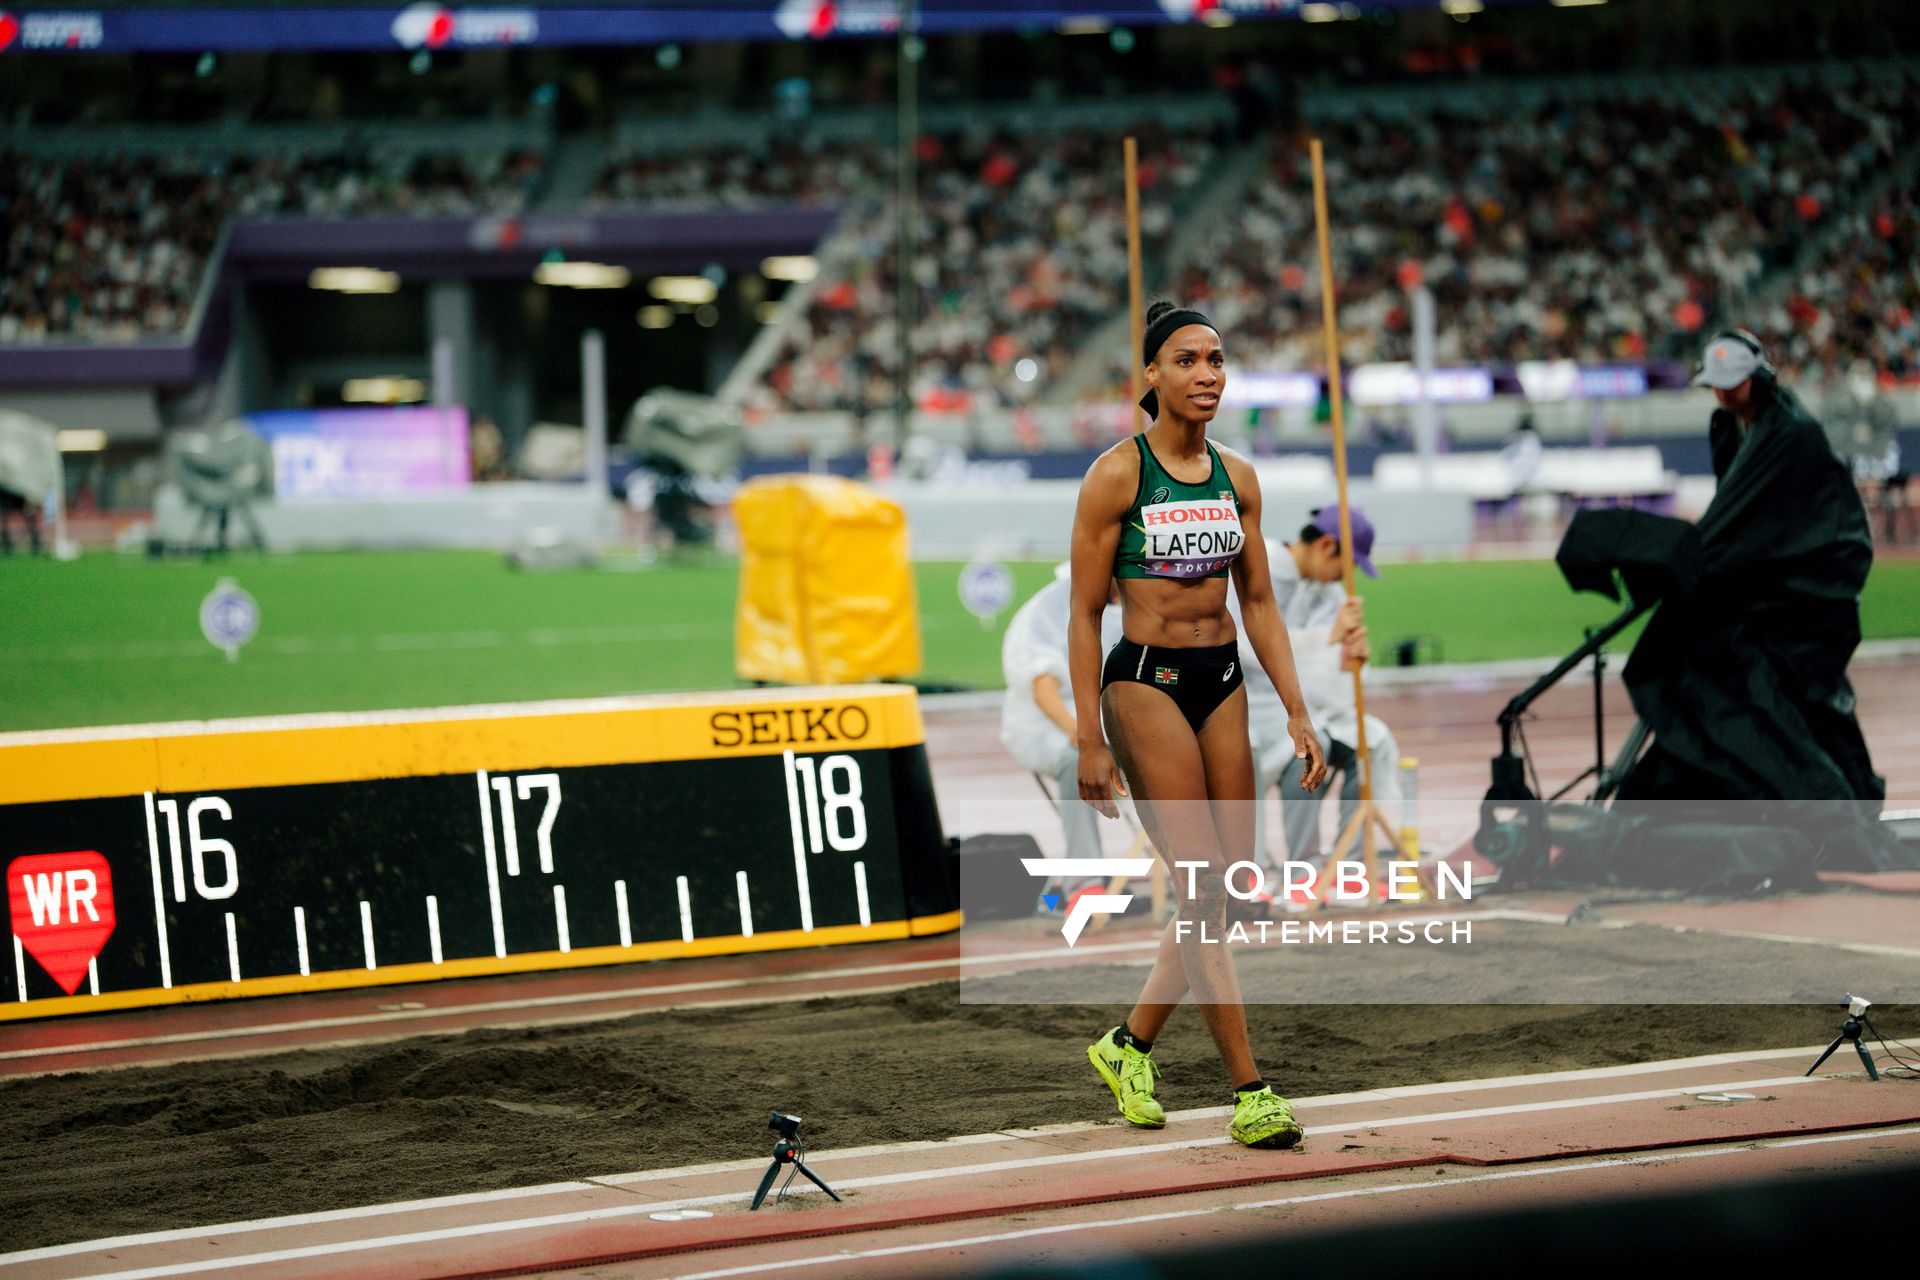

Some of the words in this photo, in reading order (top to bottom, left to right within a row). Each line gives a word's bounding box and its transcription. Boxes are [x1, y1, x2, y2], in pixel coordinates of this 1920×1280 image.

[1145, 507, 1238, 526] HONDA
[1152, 531, 1241, 556] LAFOND
[710, 705, 869, 747] SEIKO
[491, 773, 562, 877] 17
[795, 754, 868, 854] 18
[157, 796, 239, 903] 16
[22, 869, 100, 927] WR
